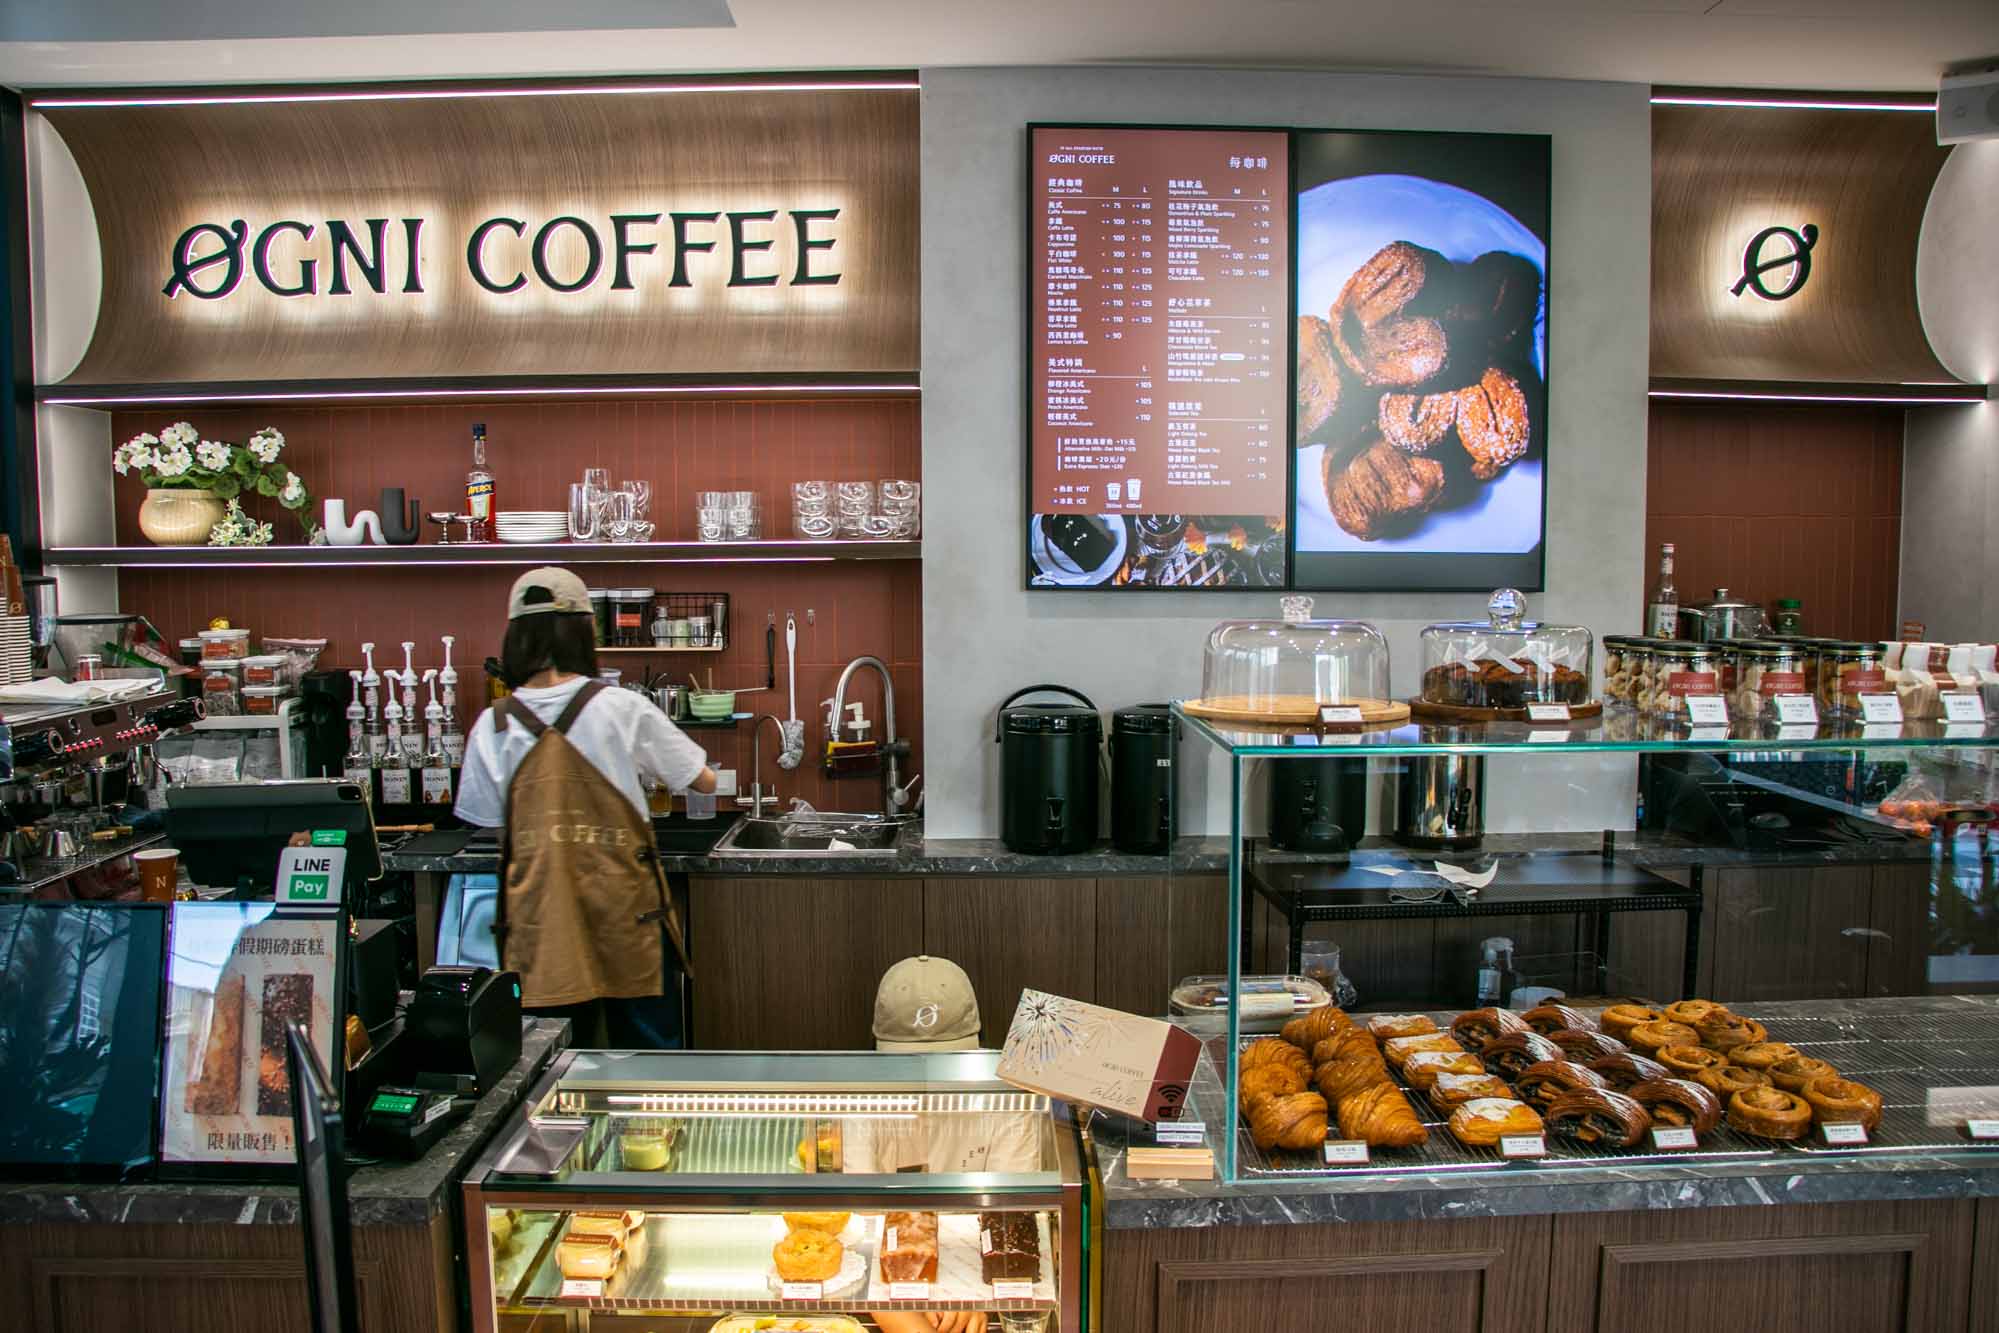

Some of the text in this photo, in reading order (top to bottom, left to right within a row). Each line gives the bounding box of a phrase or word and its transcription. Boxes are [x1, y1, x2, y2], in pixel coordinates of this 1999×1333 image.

[1078, 154, 1115, 164] COFFEE
[467, 208, 843, 294] COFFEE
[293, 858, 331, 872] LINE
[295, 879, 325, 896] Pay
[232, 936, 325, 956] 假期磅蛋糕
